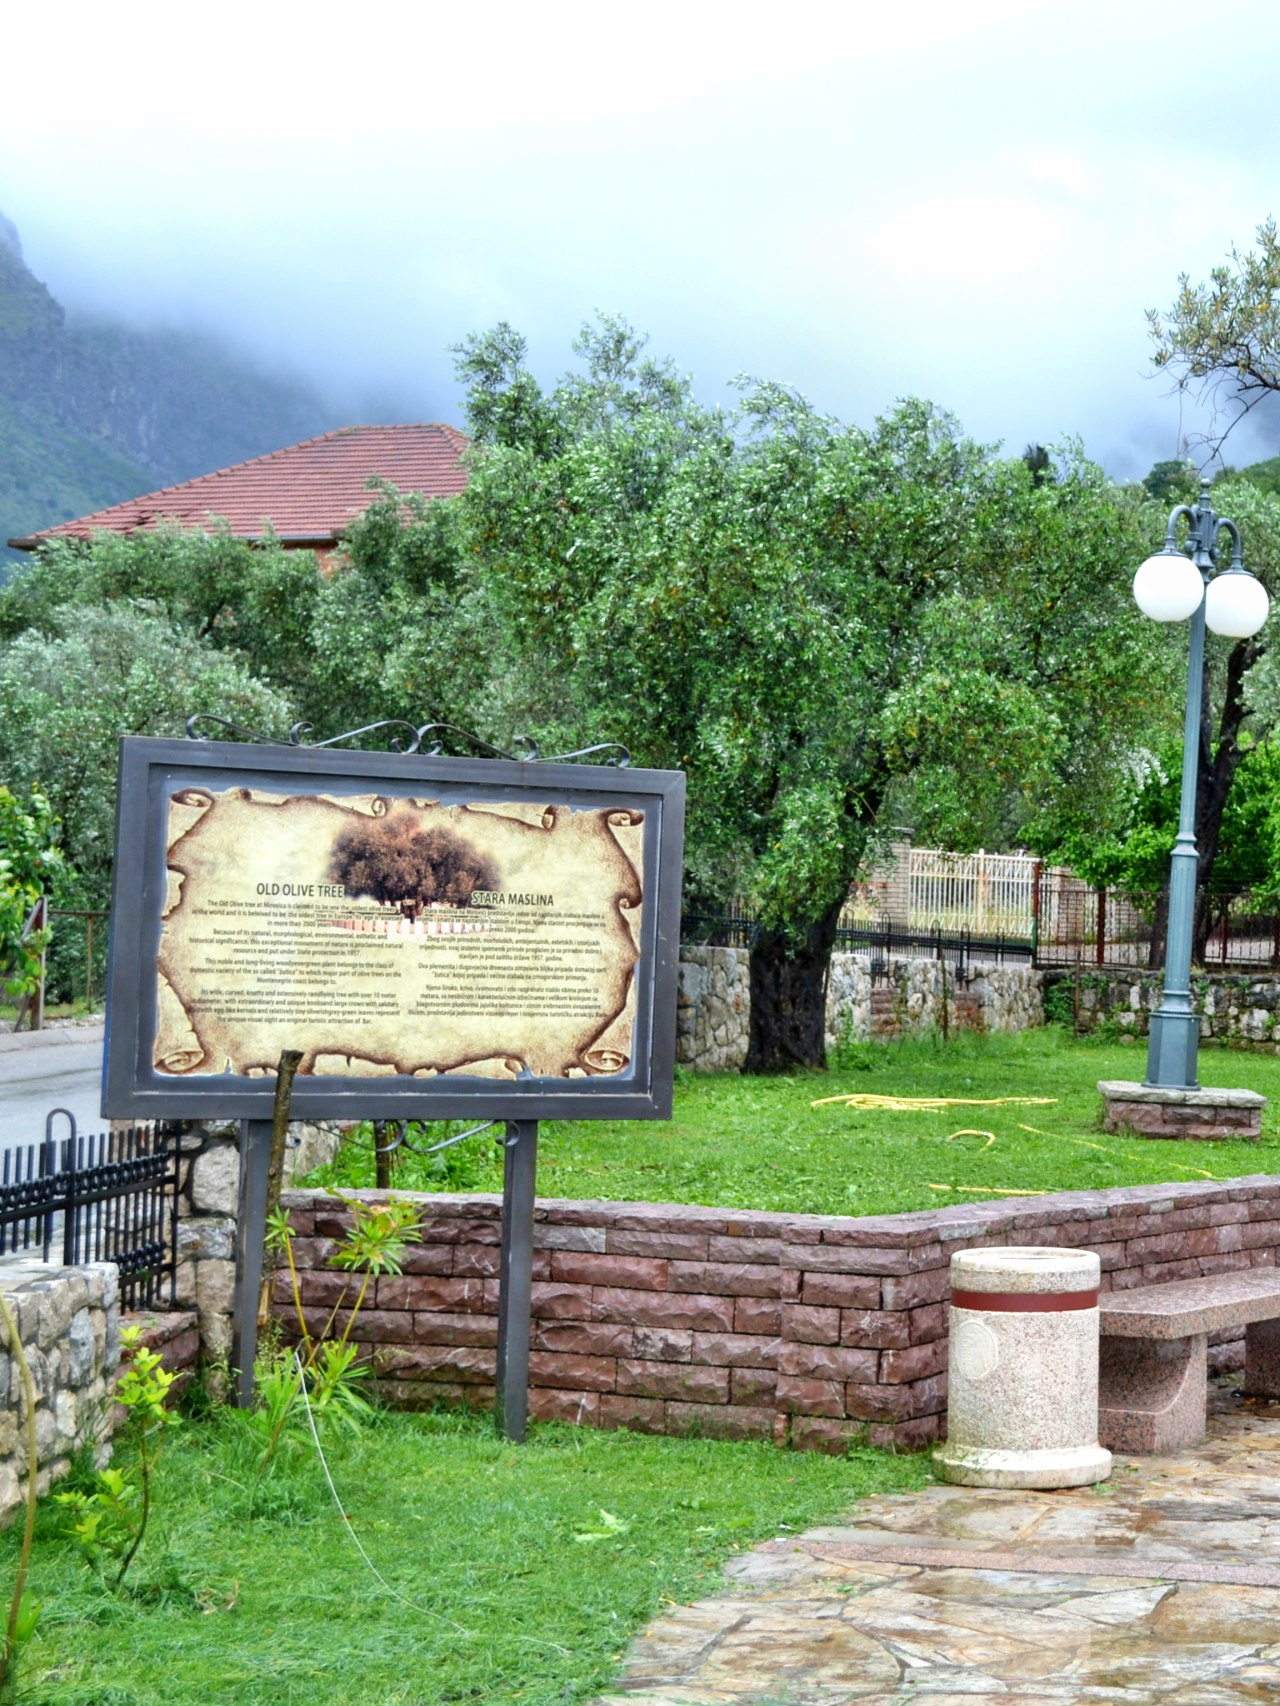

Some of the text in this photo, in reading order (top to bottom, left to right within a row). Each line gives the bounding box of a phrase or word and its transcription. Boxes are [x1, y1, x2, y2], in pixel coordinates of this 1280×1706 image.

[256, 882, 344, 898] OLD OLIVE TREE
[472, 892, 554, 906] STARA MASLINA
